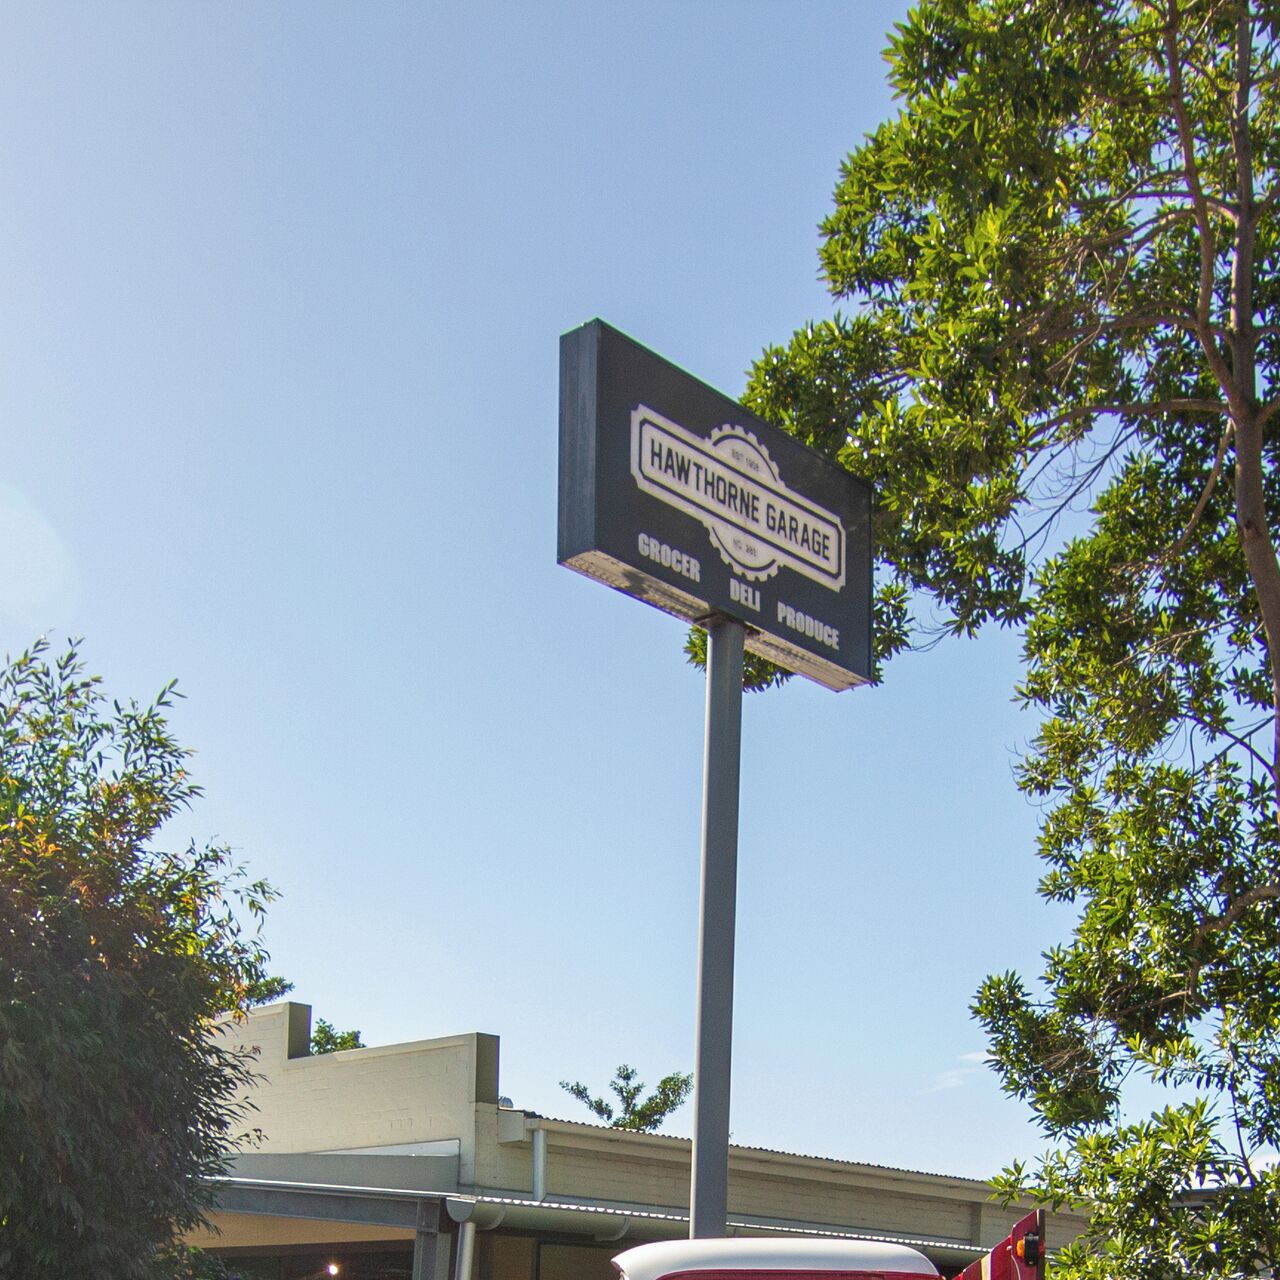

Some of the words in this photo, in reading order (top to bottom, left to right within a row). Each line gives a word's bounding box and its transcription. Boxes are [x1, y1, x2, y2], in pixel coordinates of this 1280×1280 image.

[651, 439, 759, 523] HAWTHORNE
[766, 503, 830, 561] GARAGE
[638, 533, 701, 582] GROCER
[730, 578, 761, 612] DELI
[777, 601, 839, 650] PRODUCE
